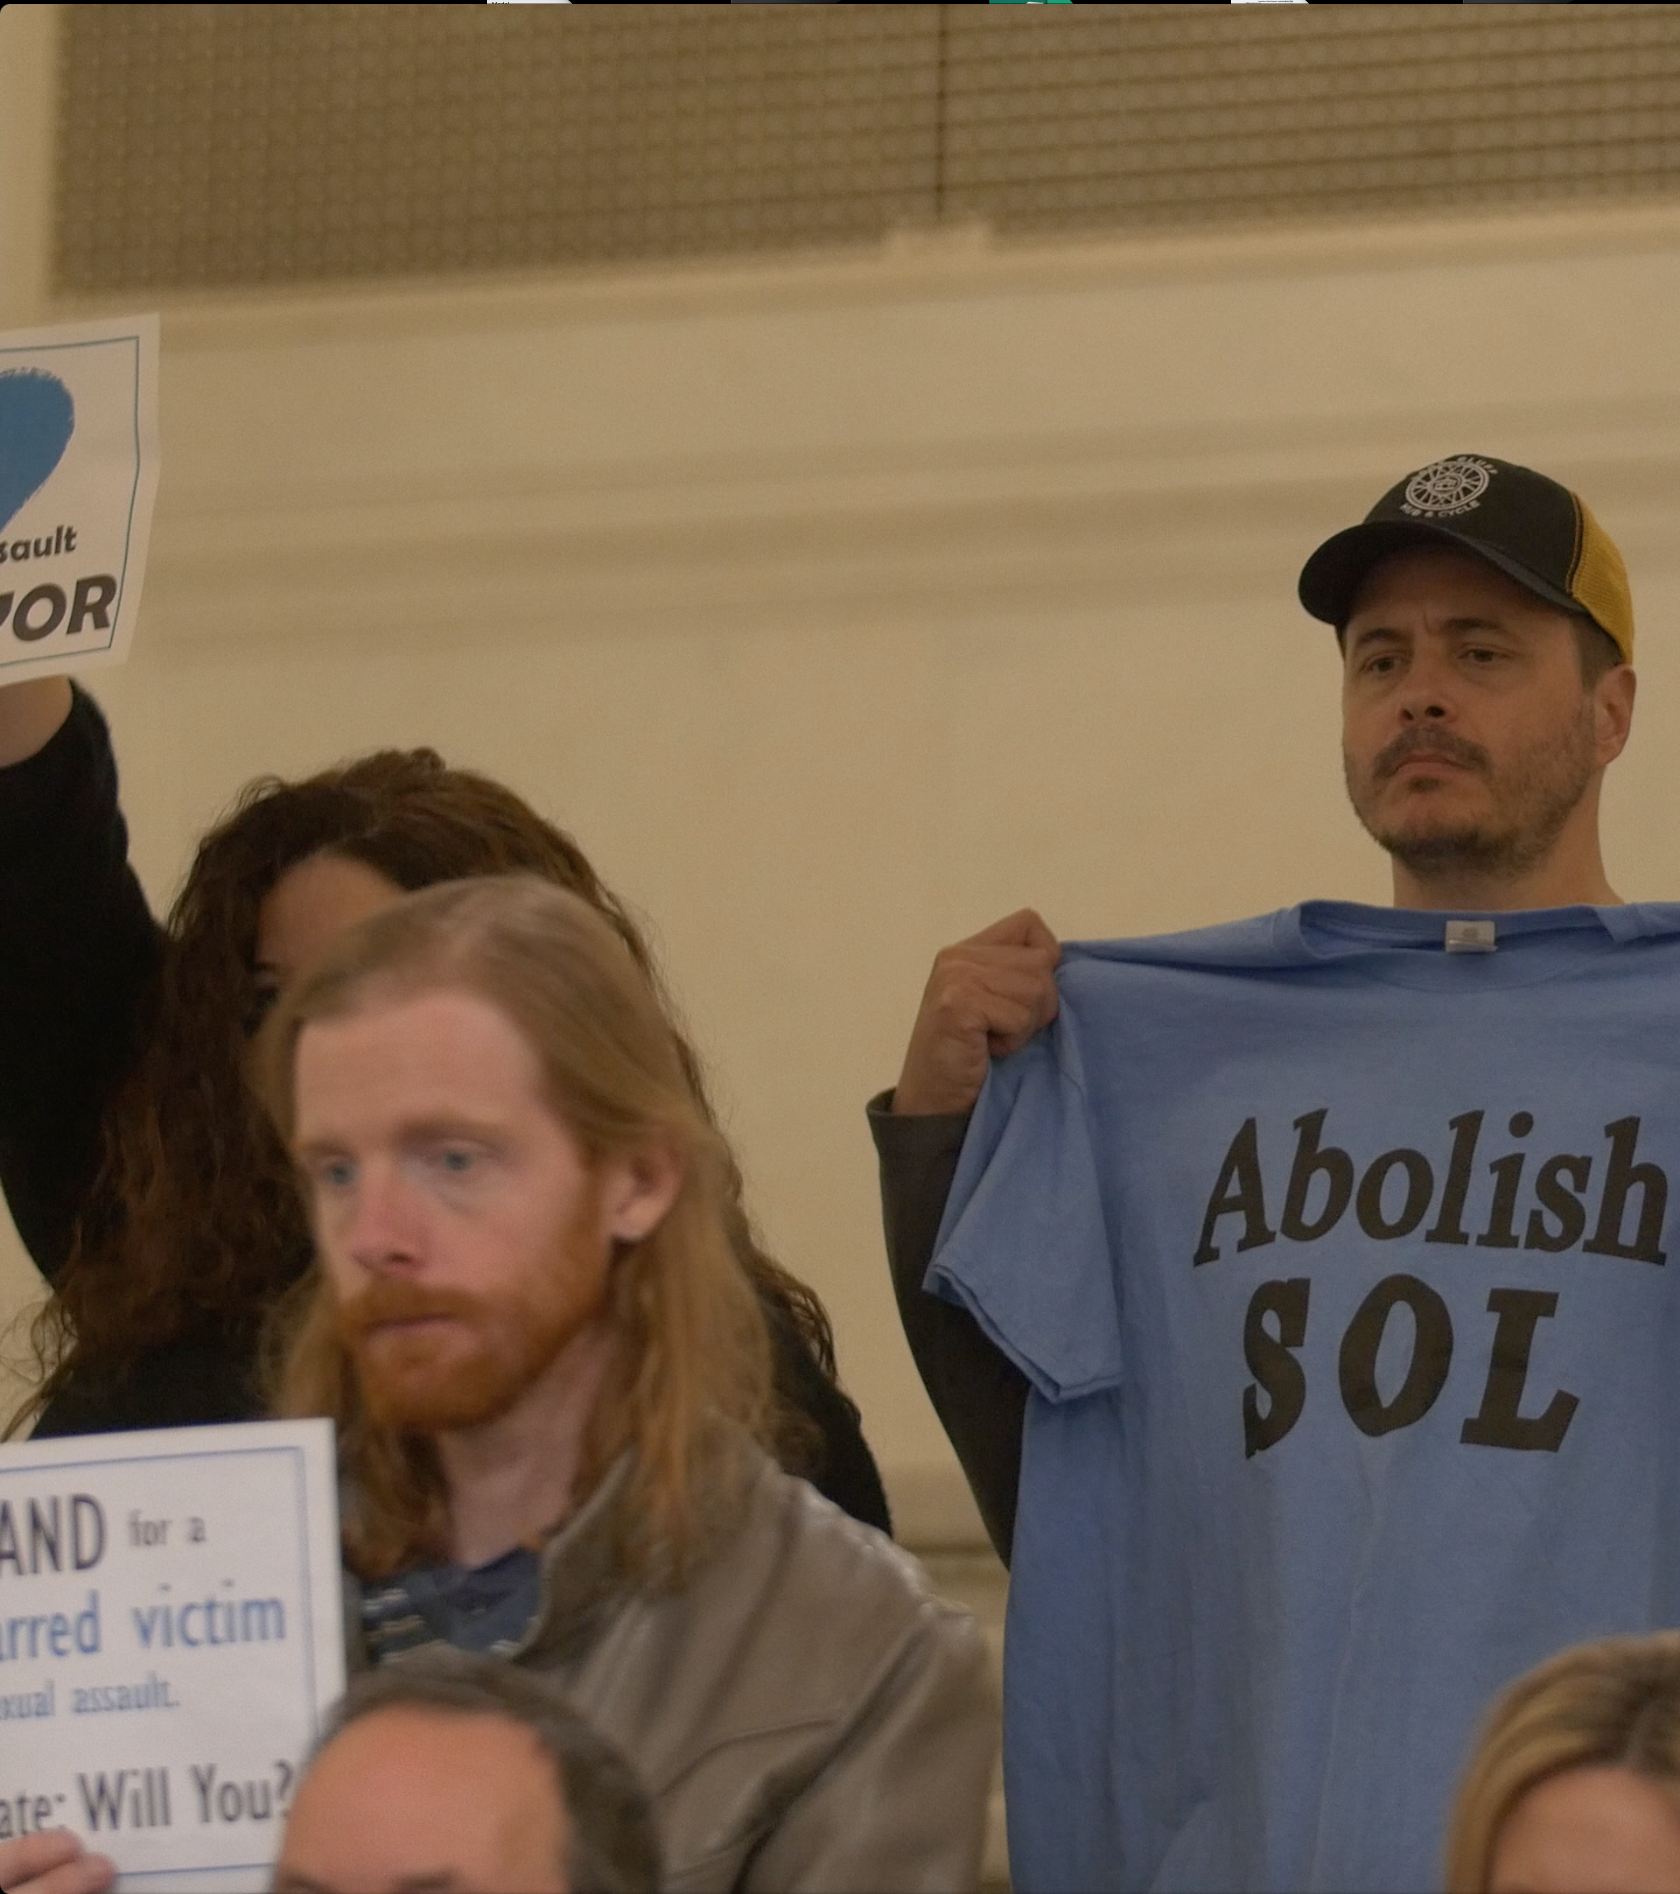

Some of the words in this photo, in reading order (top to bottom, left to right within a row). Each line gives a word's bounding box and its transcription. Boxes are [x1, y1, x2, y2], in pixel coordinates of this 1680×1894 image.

[1438, 500, 1481, 517] CYCLE
[1192, 1107, 1669, 1268] Abolish
[1242, 1272, 1581, 1461] SOL
[0, 1492, 107, 1577] AND
[126, 1508, 172, 1548] for
[187, 1515, 208, 1544] a
[0, 1589, 102, 1662] rred
[130, 1577, 287, 1651] victim
[71, 1669, 182, 1715] assault.
[75, 1765, 173, 1833] Will
[188, 1757, 295, 1825] You?
